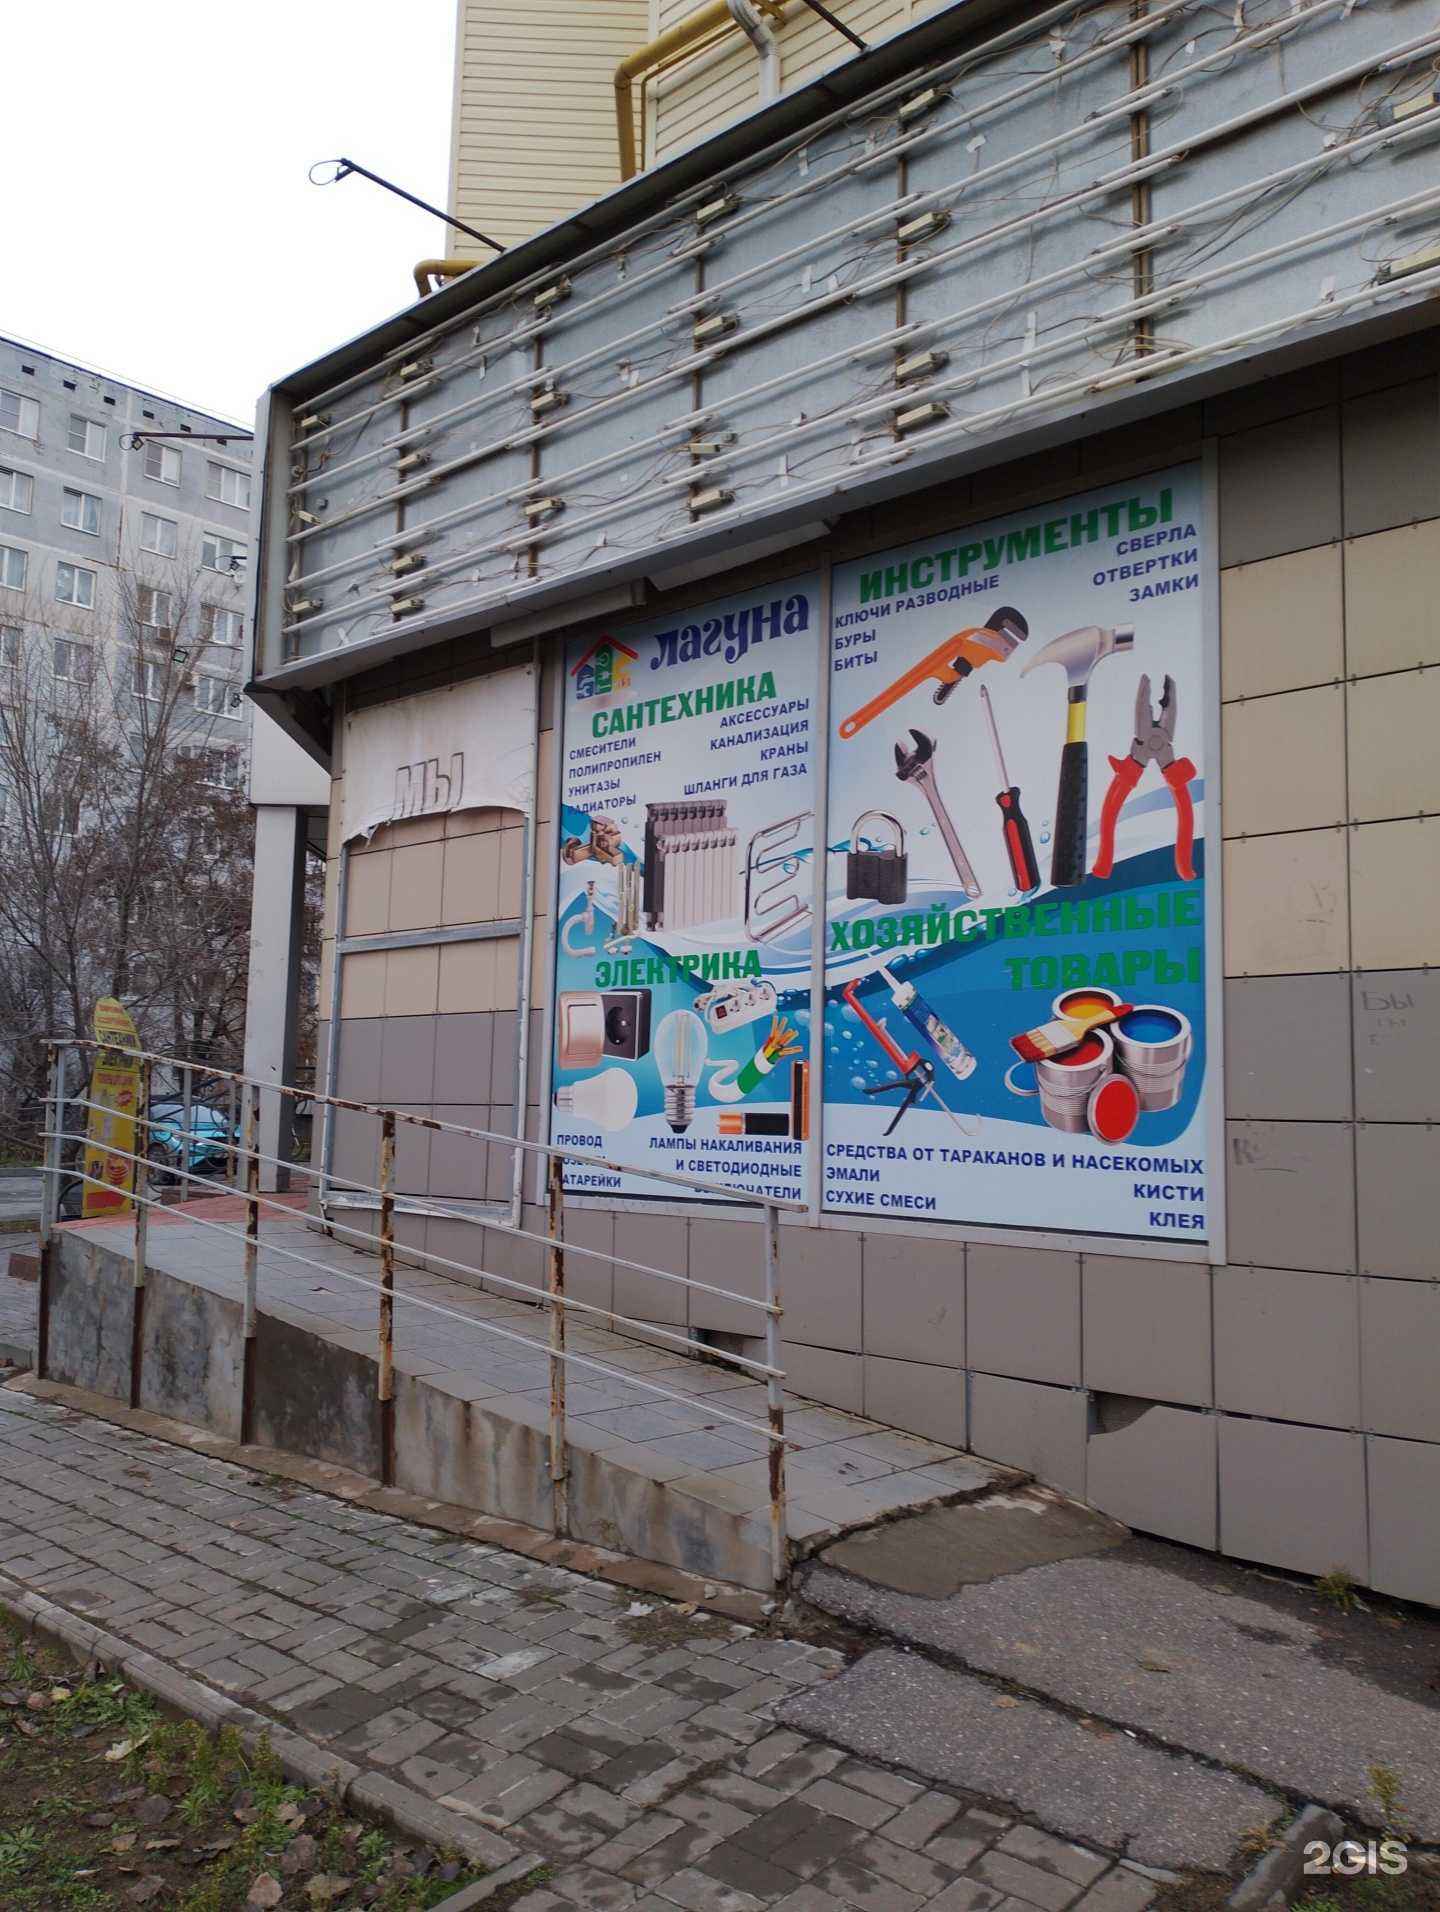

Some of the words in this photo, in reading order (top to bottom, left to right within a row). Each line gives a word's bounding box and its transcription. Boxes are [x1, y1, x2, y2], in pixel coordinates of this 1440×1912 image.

[859, 487, 1173, 603] ИНСТРУМЕНТЫ
[1116, 523, 1197, 556] СВЕРЛА
[1092, 548, 1198, 587] ОТВЕРТКИ
[835, 602, 891, 629] КЛЮЧИ
[895, 574, 1000, 613] РАЗВОДНЫЕ
[1129, 573, 1199, 602] ЗАМКИ
[834, 629, 876, 651] БУРЫ
[834, 650, 878, 672] БИТЫ
[592, 671, 777, 738] САНТЕХНИКА
[720, 698, 809, 728] АКСЕССУАРЫ
[569, 737, 636, 760] СМЕСИТЕЛИ
[710, 720, 808, 750] КАНАЛИЗАЦИЯ
[568, 751, 661, 779] ПОЛИПРОПИЛЕН
[760, 741, 808, 761] КРАНЫ
[568, 778, 620, 797] УНИТАЗЫ
[684, 776, 737, 796] ШЛАНГИ
[741, 770, 769, 787] ДЛЯ
[773, 762, 808, 780] ГАЗА
[830, 889, 1201, 951] ХОЗЯЙСТВЕННЫЕ
[595, 949, 761, 988] ЭЛЕКТРИКА
[1004, 947, 1201, 992] ТОВАРЫ
[557, 1134, 602, 1149] ПРОВОД
[649, 1137, 697, 1151] ЛАМПЫ
[701, 1139, 802, 1155] НАКАЛИВАНИЯ
[676, 1159, 684, 1171] И
[688, 1159, 802, 1178] СВЕТОДИОДНЫЕ
[826, 1143, 907, 1161] СРЕДСТВА
[912, 1146, 933, 1162] ОТ
[940, 1148, 1045, 1168] ТАРАКАНОВ
[1052, 1153, 1065, 1168] И
[1072, 1155, 1204, 1175] НАСЕКОМЫХ
[561, 1173, 621, 1188] АТАРЕЙКИ
[826, 1166, 880, 1183] ЭМАЛИ
[825, 1189, 874, 1206] СУХИЕ
[880, 1192, 936, 1210] СМЕСИ
[1133, 1183, 1204, 1202] КИСТИ
[1149, 1211, 1204, 1230] КЛЕЯ
